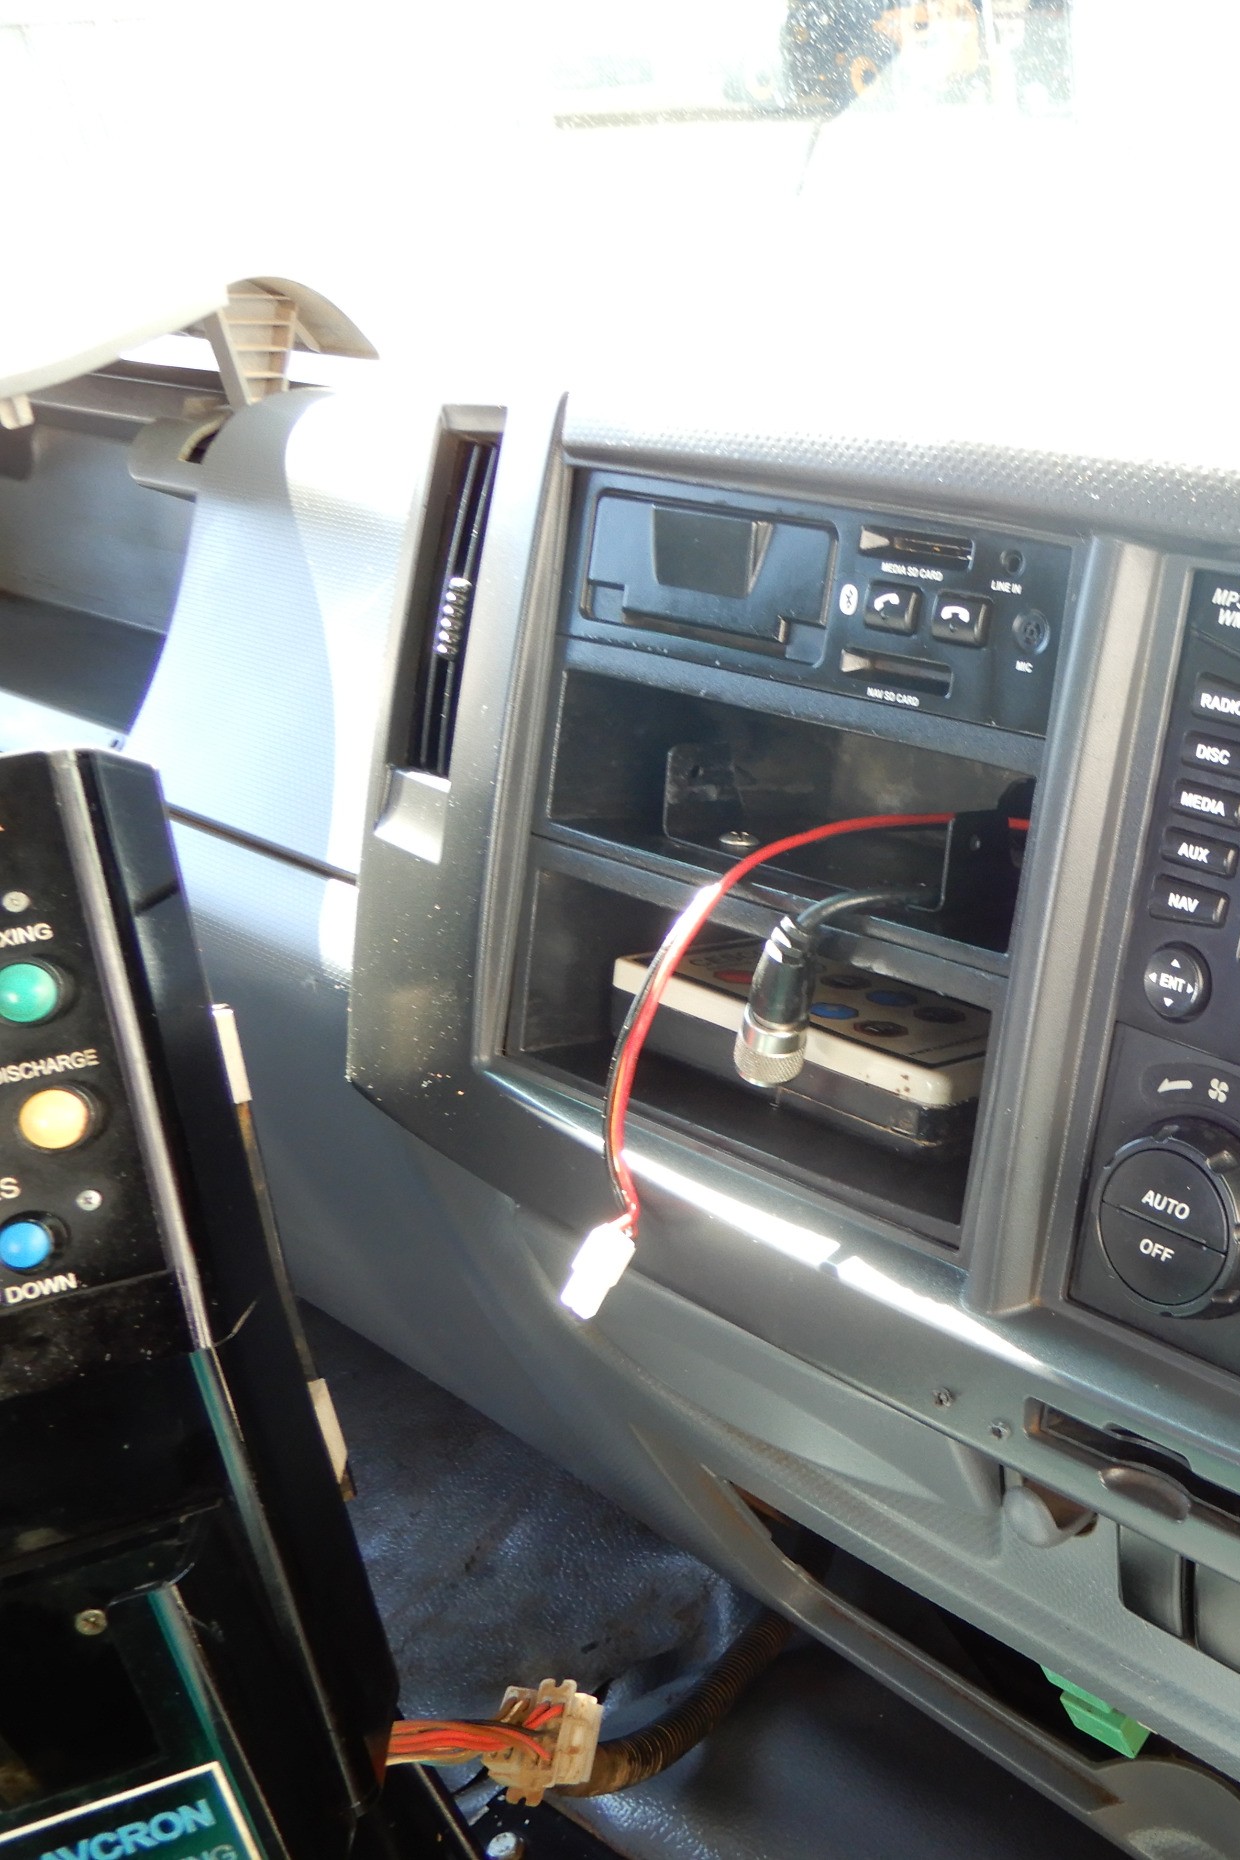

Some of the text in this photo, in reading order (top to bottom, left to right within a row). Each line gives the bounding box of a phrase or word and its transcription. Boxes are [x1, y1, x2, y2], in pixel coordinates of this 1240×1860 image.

[881, 562, 944, 581] MEDIA SD CARD
[991, 580, 1023, 594] LINE IN
[1015, 660, 1033, 674] MIC
[867, 687, 920, 707] NAV SD CARD
[1196, 743, 1231, 765] DISC
[1180, 791, 1226, 817] MEDIA
[1177, 842, 1210, 864] AUX
[1168, 893, 1200, 914] NAV
[1159, 972, 1186, 993] ENT
[0, 1048, 100, 1085] ISCHARGE
[1141, 1189, 1190, 1220] AUTO
[1139, 1238, 1175, 1262] OFF
[4, 1272, 78, 1304] DOWN
